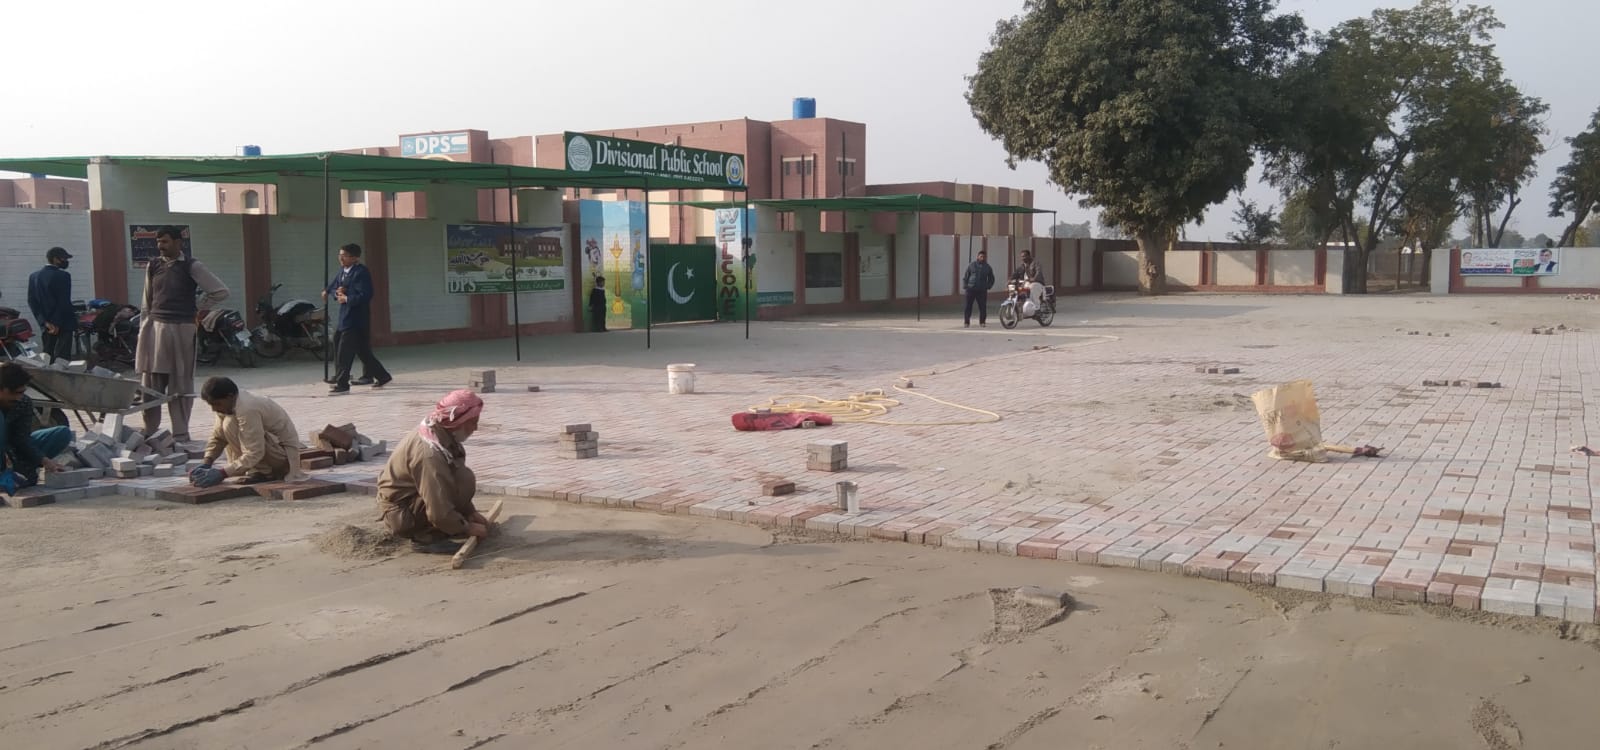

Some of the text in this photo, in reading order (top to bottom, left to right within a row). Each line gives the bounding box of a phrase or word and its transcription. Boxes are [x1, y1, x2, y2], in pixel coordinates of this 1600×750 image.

[416, 136, 450, 154] DPS
[596, 140, 657, 170] Divisional
[661, 149, 691, 172] Public
[693, 154, 723, 177] School
[718, 209, 740, 316] WELCOME
[450, 279, 477, 293] DPS
